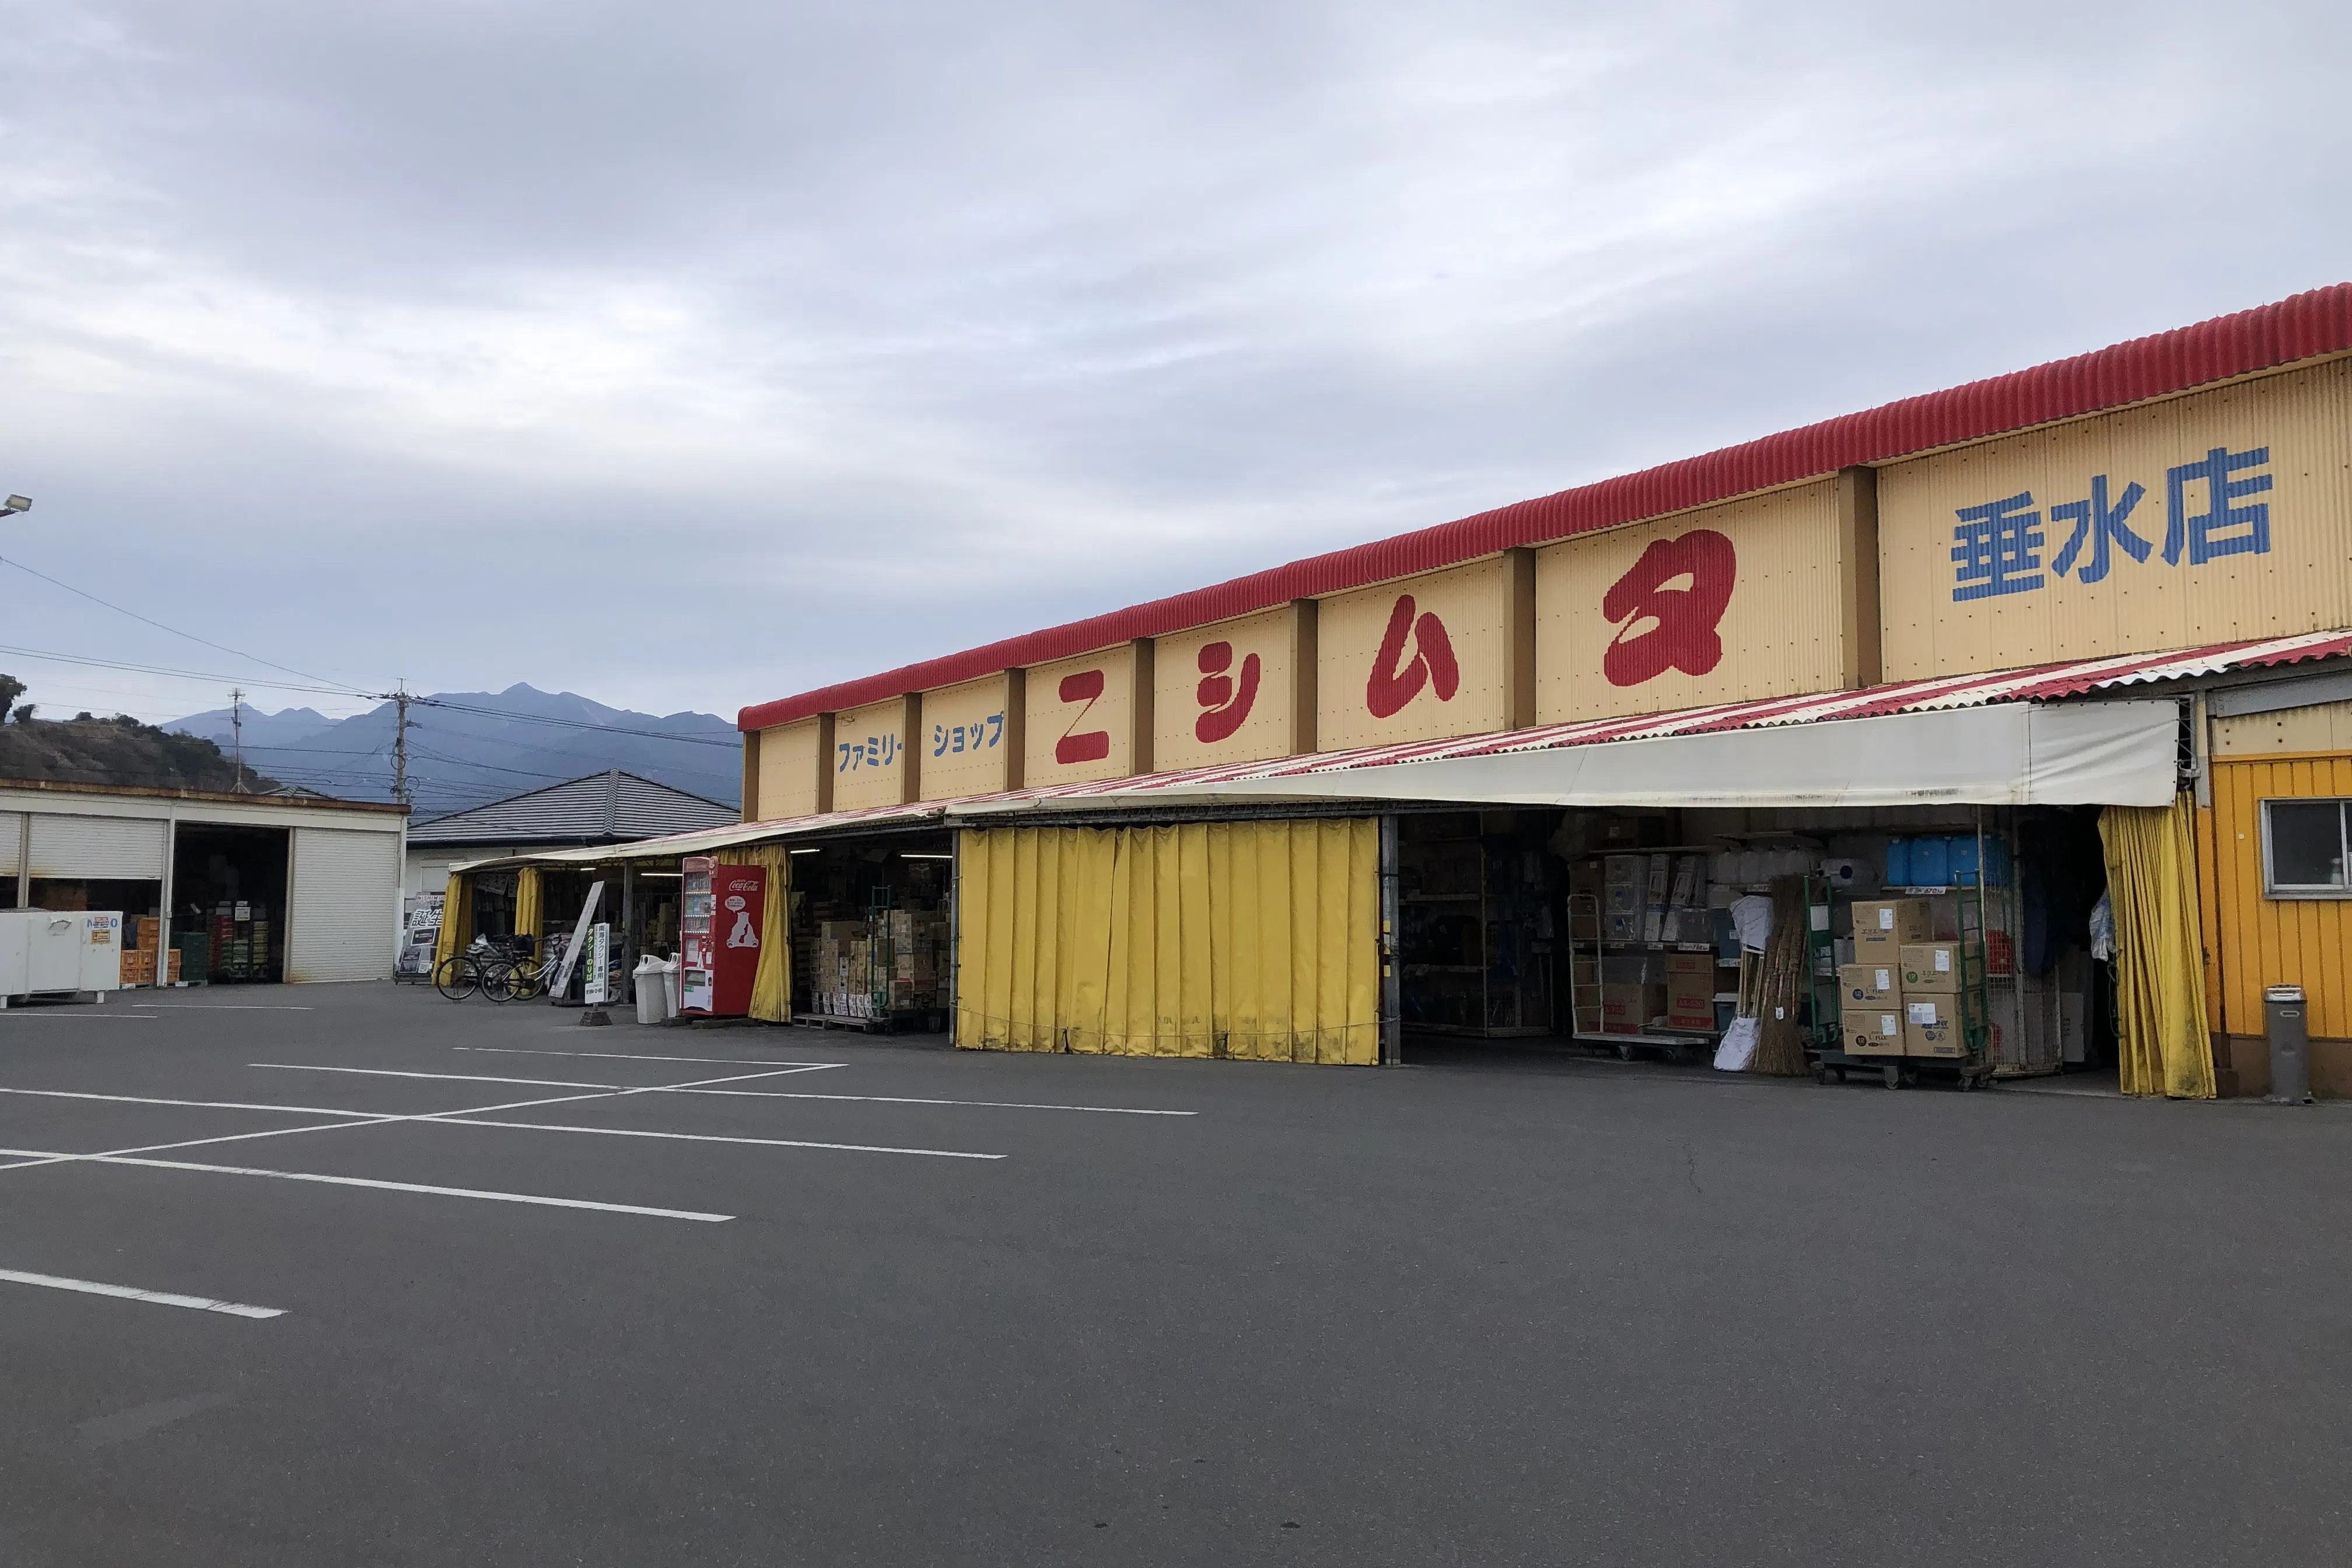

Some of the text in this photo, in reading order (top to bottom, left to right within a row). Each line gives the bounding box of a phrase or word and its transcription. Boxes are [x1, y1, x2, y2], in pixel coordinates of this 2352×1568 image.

[1951, 447, 2273, 602] 垂水店
[1056, 528, 1736, 765] ニシムタ
[934, 710, 1003, 757] ショップ
[411, 909, 443, 928] 誕生
